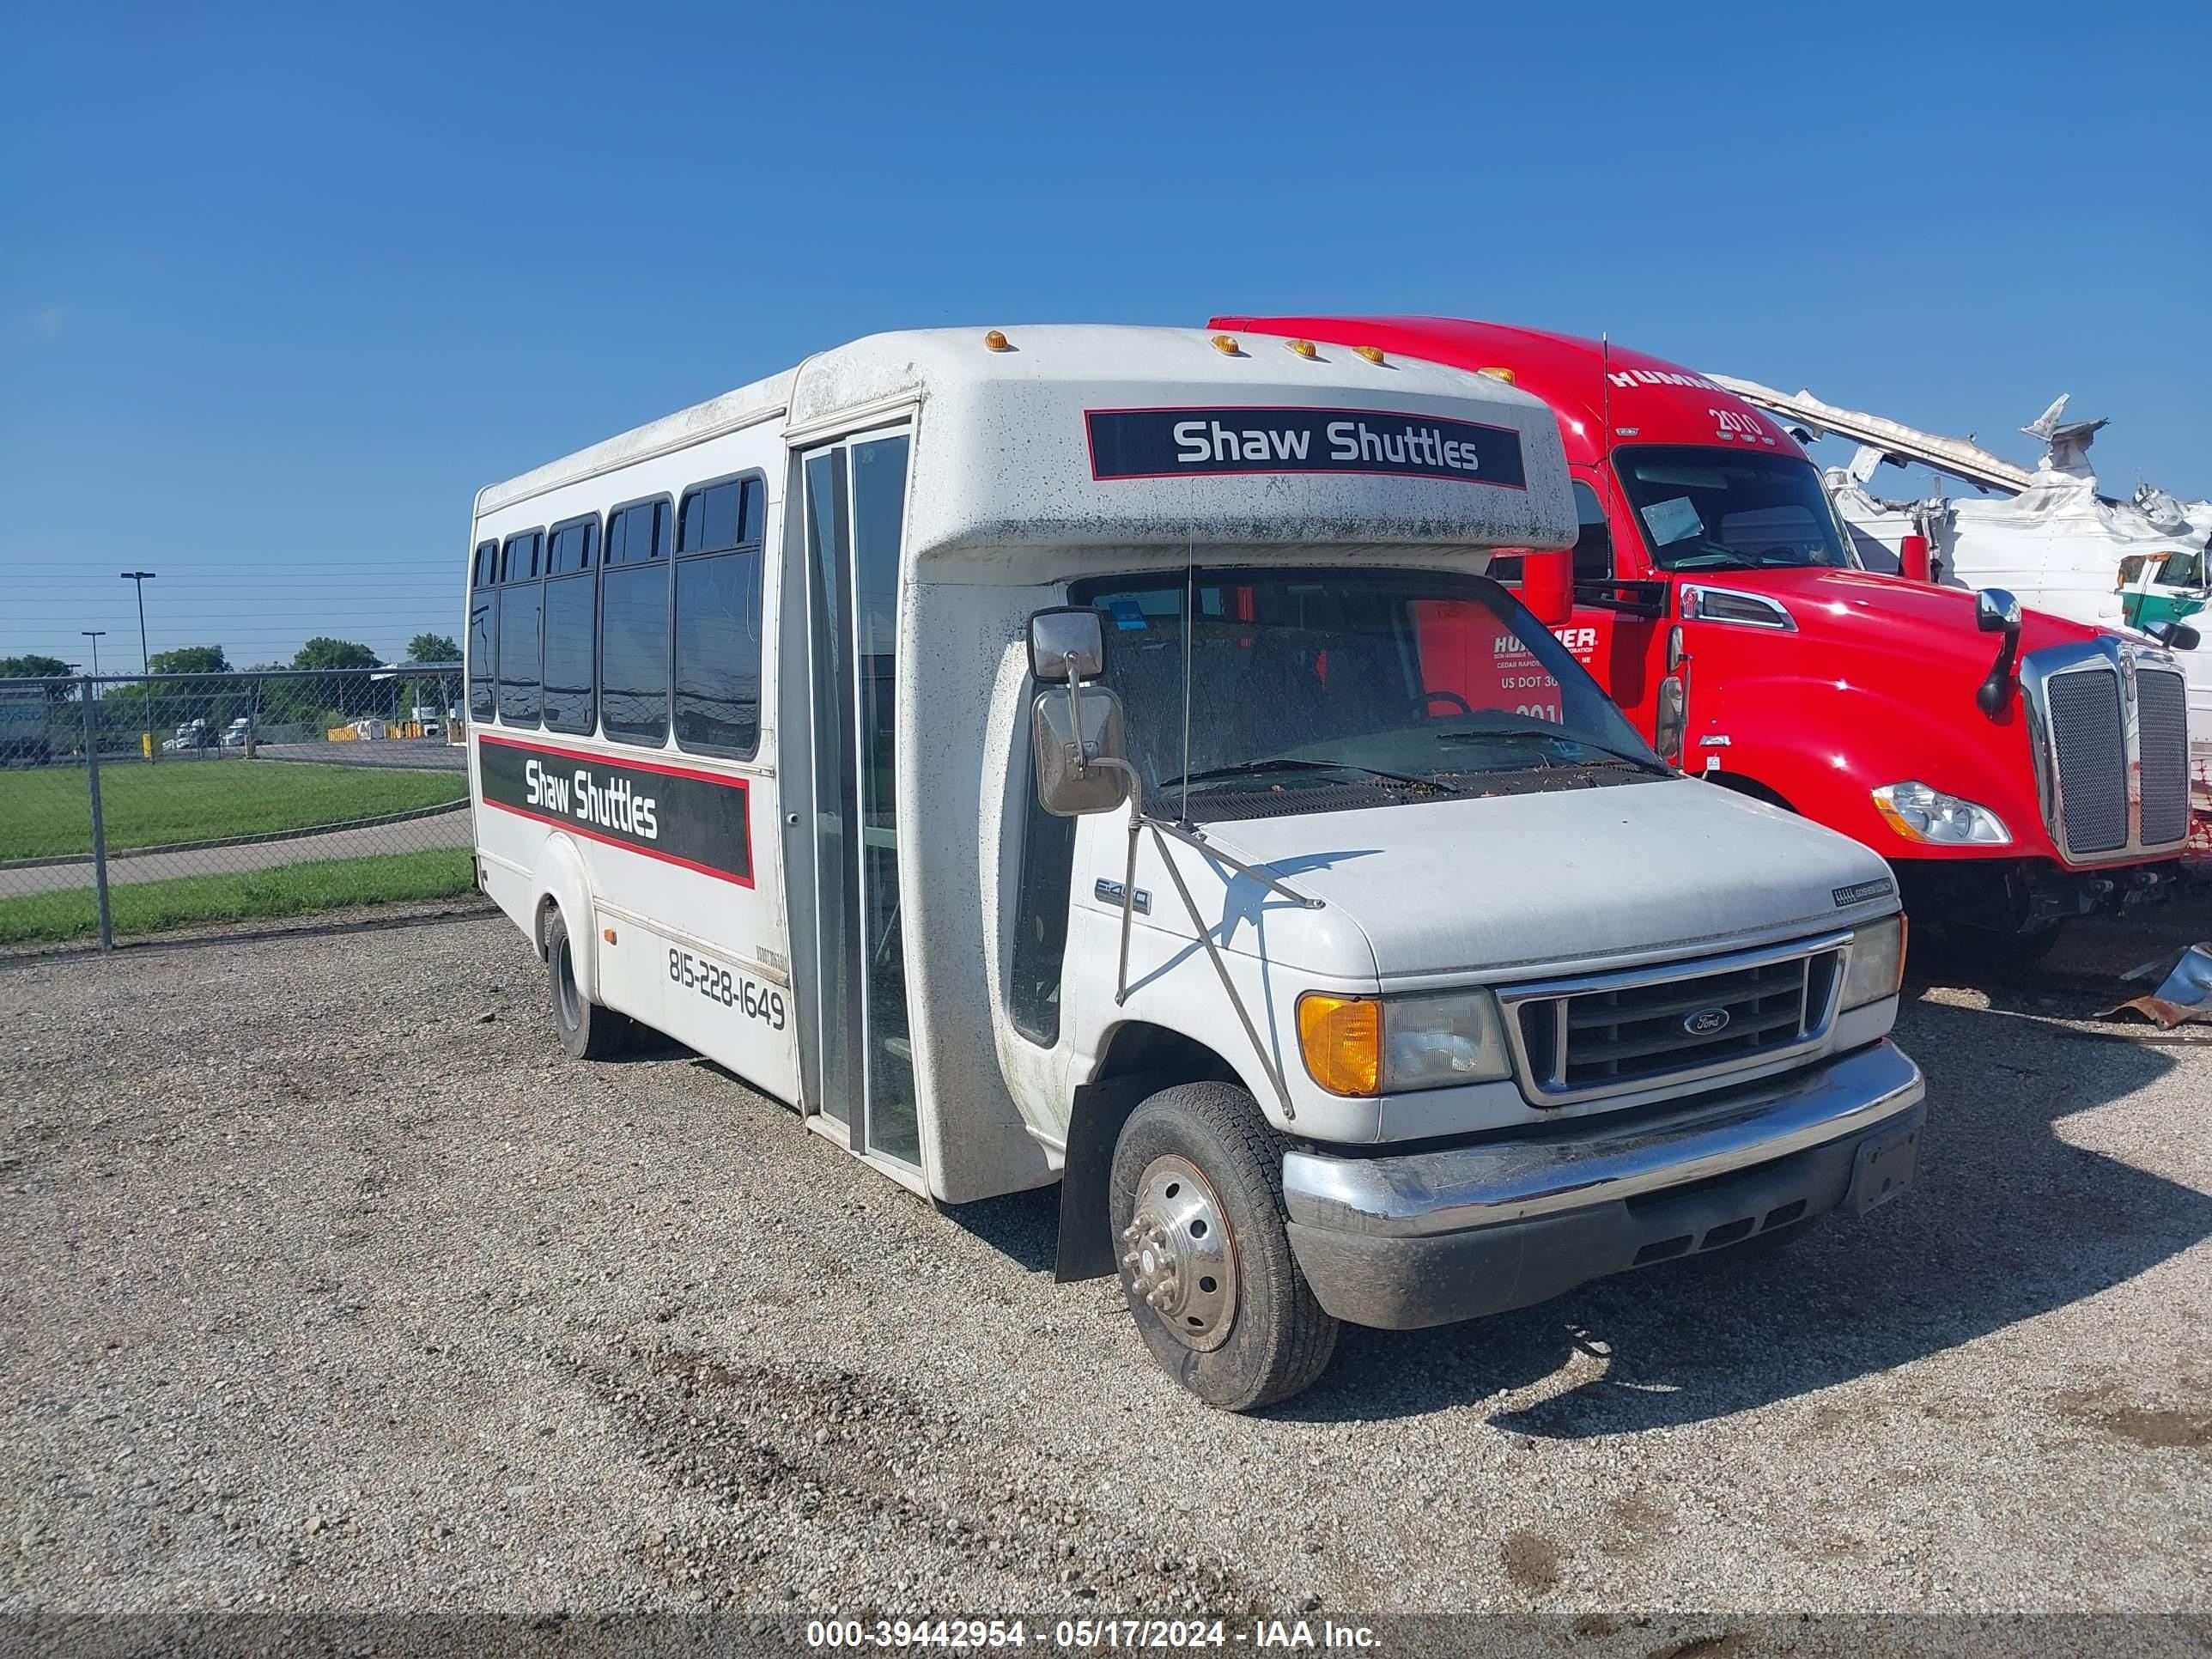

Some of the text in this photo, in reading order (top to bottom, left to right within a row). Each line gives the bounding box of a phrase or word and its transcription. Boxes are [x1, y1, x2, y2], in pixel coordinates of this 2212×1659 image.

[1607, 369, 1728, 392] HUMM
[1709, 408, 1763, 435] 2010
[1172, 420, 1479, 471] Shaw Shuttles
[1501, 677, 1515, 689] US
[1518, 676, 1541, 688] DOT
[525, 759, 659, 840] Shaw Shuttles
[669, 948, 785, 1031] 815-228-1649
[1697, 1013, 1721, 1030] Ford
